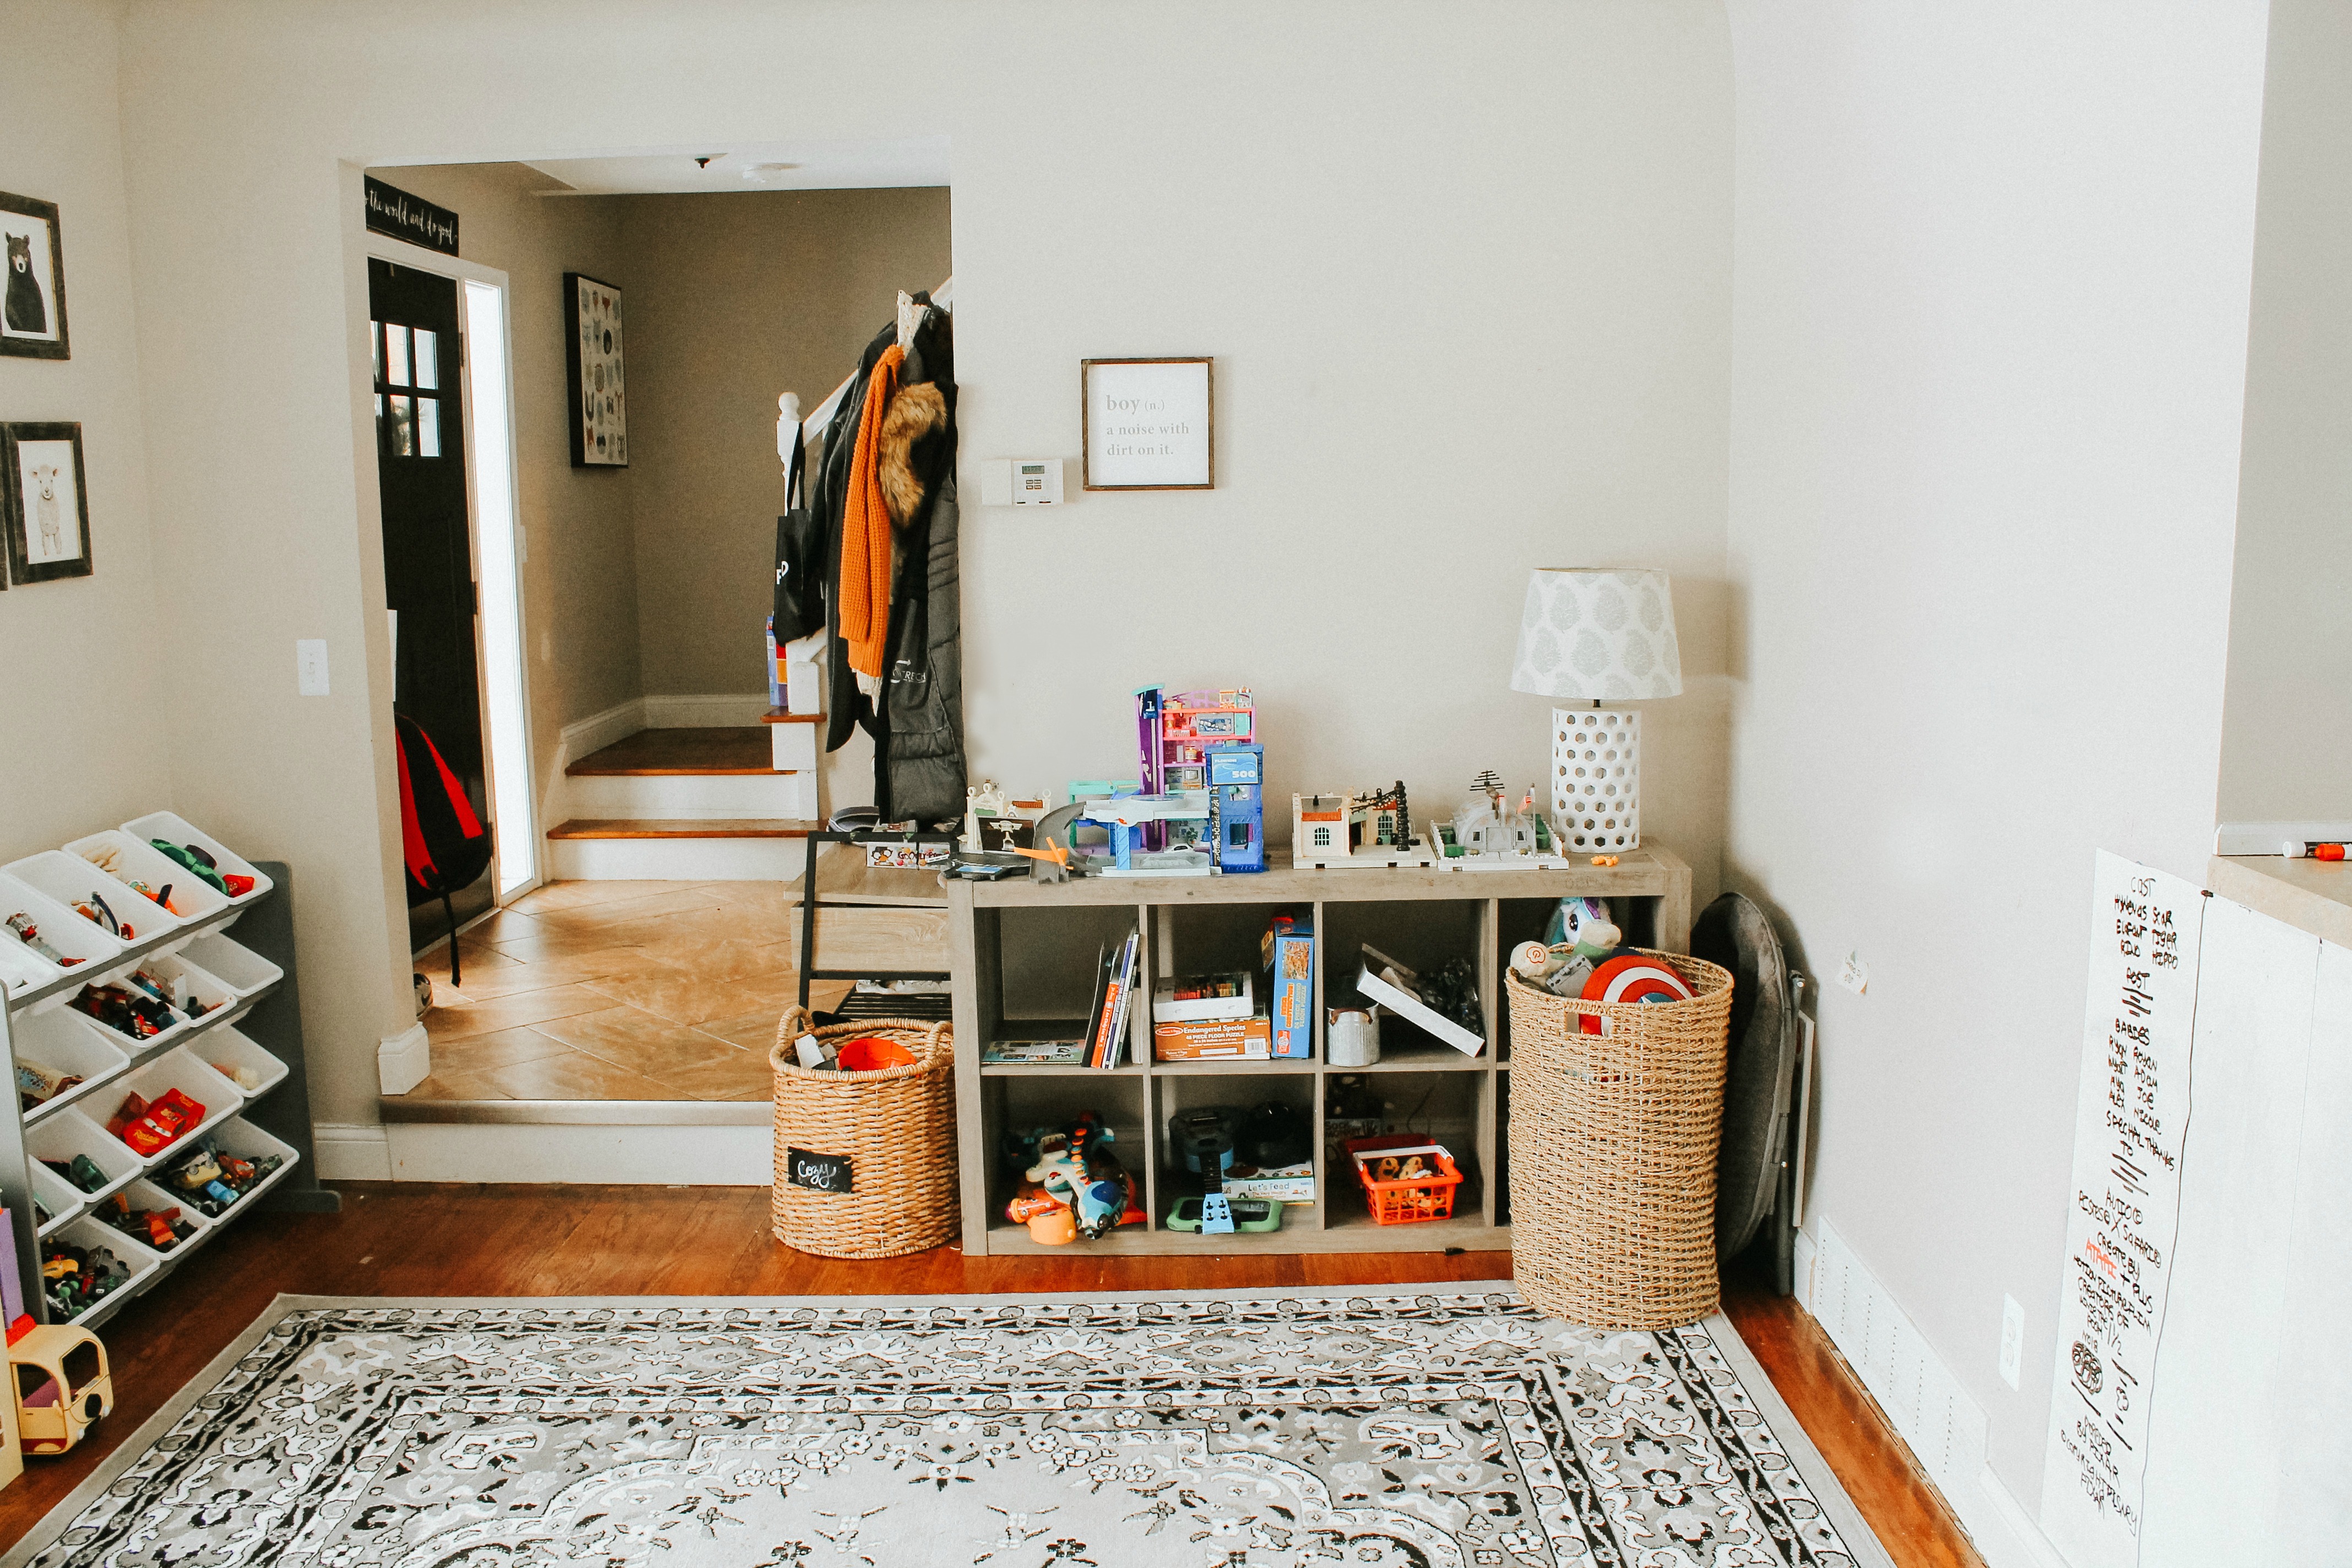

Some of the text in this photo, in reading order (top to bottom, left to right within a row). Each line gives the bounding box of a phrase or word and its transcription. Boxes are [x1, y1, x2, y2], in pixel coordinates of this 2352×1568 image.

[370, 188, 383, 211] the
[385, 196, 407, 226] world
[410, 209, 426, 232] and
[427, 211, 437, 237] do
[438, 220, 458, 246] good
[1106, 395, 1164, 415] boy (n.)
[1107, 422, 1189, 435] a noise with
[1107, 444, 1174, 456] dirt on it.
[1232, 770, 1256, 778] 500
[1184, 1024, 1246, 1034] Endangered Species
[2120, 1140, 2133, 1156] TO
[798, 1160, 837, 1189] Cozy
[1248, 1183, 1267, 1191] Let's
